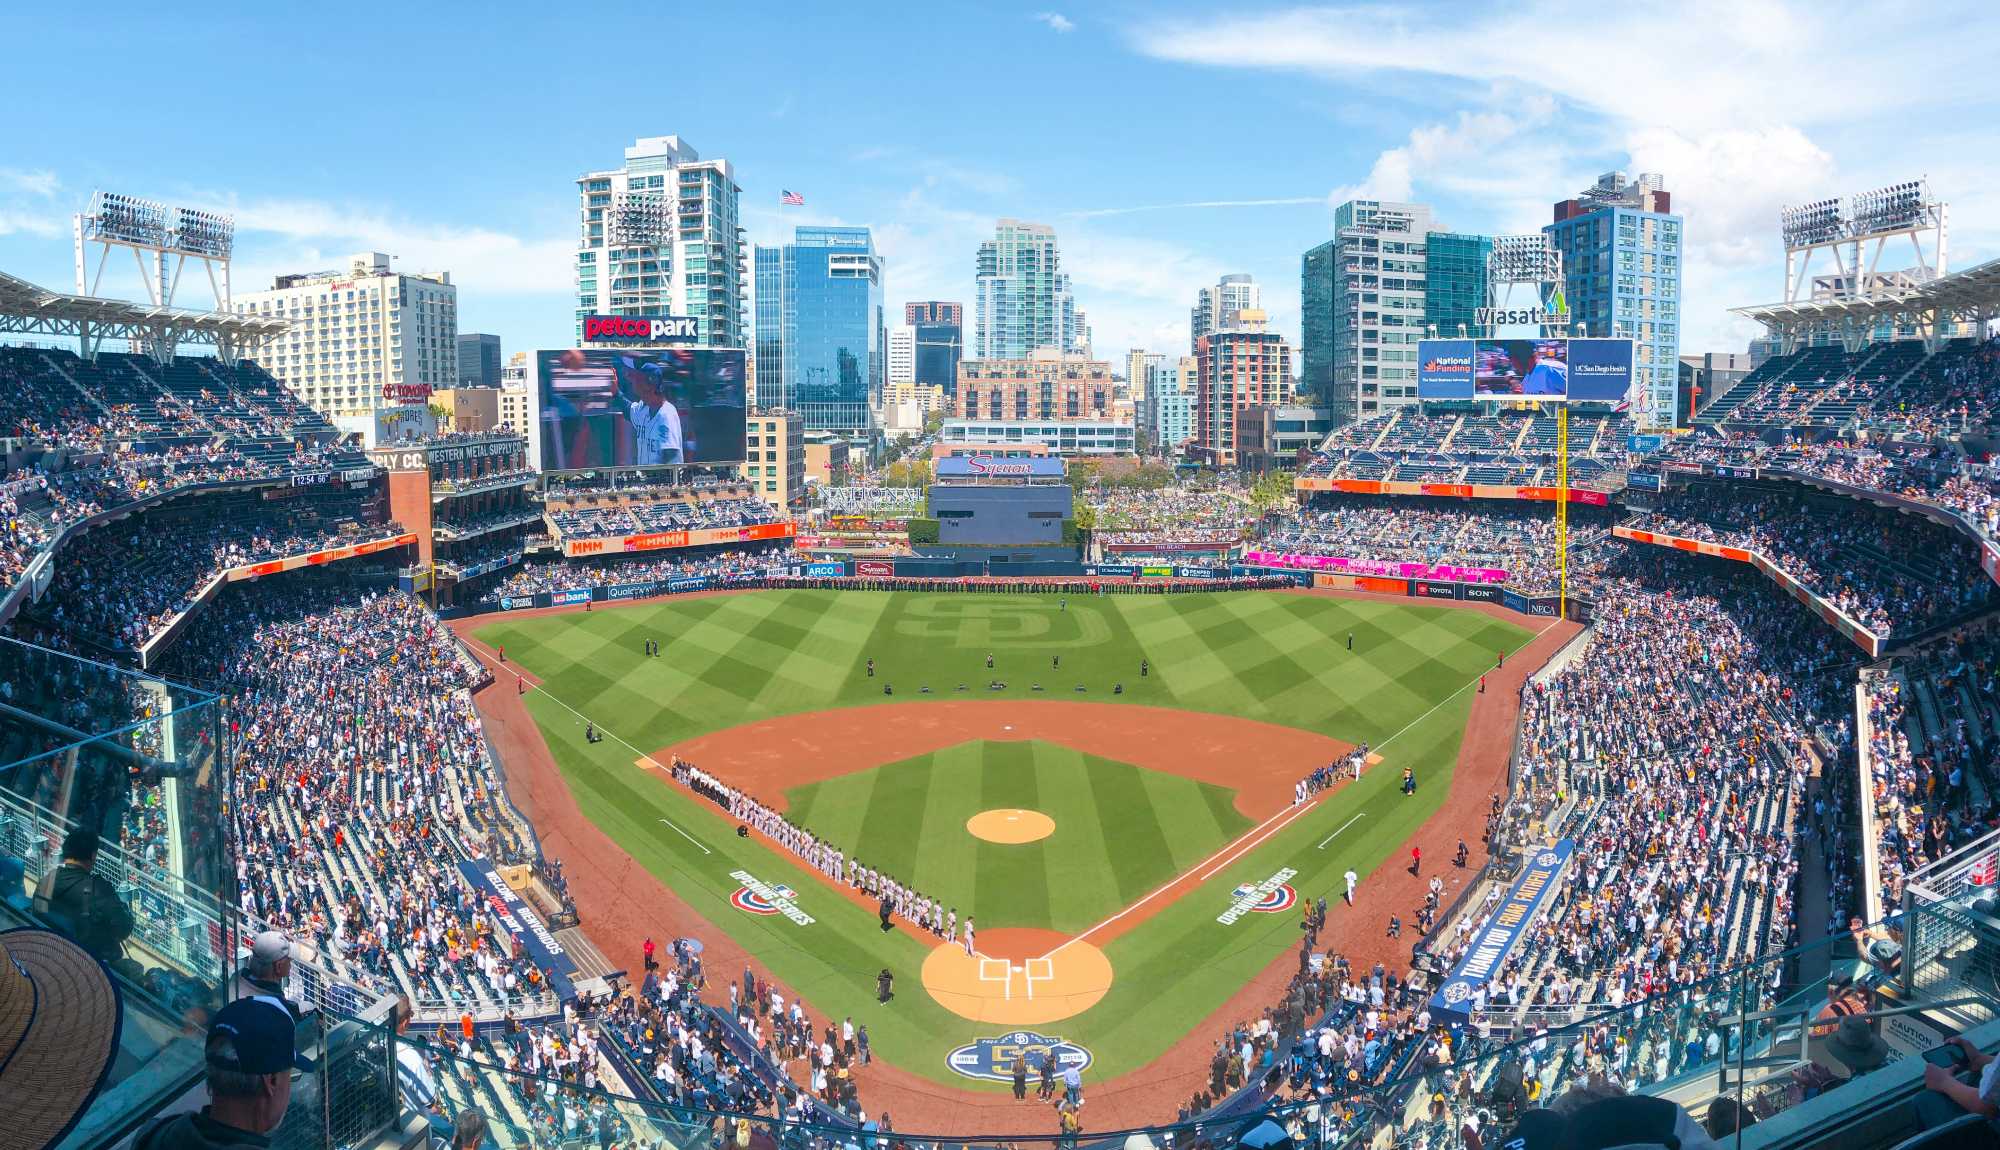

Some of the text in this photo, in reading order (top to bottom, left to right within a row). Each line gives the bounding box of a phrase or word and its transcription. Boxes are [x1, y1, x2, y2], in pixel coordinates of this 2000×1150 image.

[1477, 306, 1540, 325] Viasat
[1436, 356, 1471, 365] National
[1436, 365, 1472, 374] Funding
[429, 448, 464, 464] WESTERN
[467, 444, 489, 459] METAL
[489, 442, 513, 456] SUPPLY
[968, 451, 1034, 480] Sycuan
[296, 476, 315, 486] 12:54
[809, 566, 834, 576] ARCO
[1429, 587, 1452, 595] TOYOTA
[485, 870, 519, 903] WELCOME
[517, 907, 564, 955] BIENVENIDOS
[1460, 869, 1553, 979] THANK YOU FRIAR FAITHFUL
[1891, 1019, 1933, 1046] CAUTION
